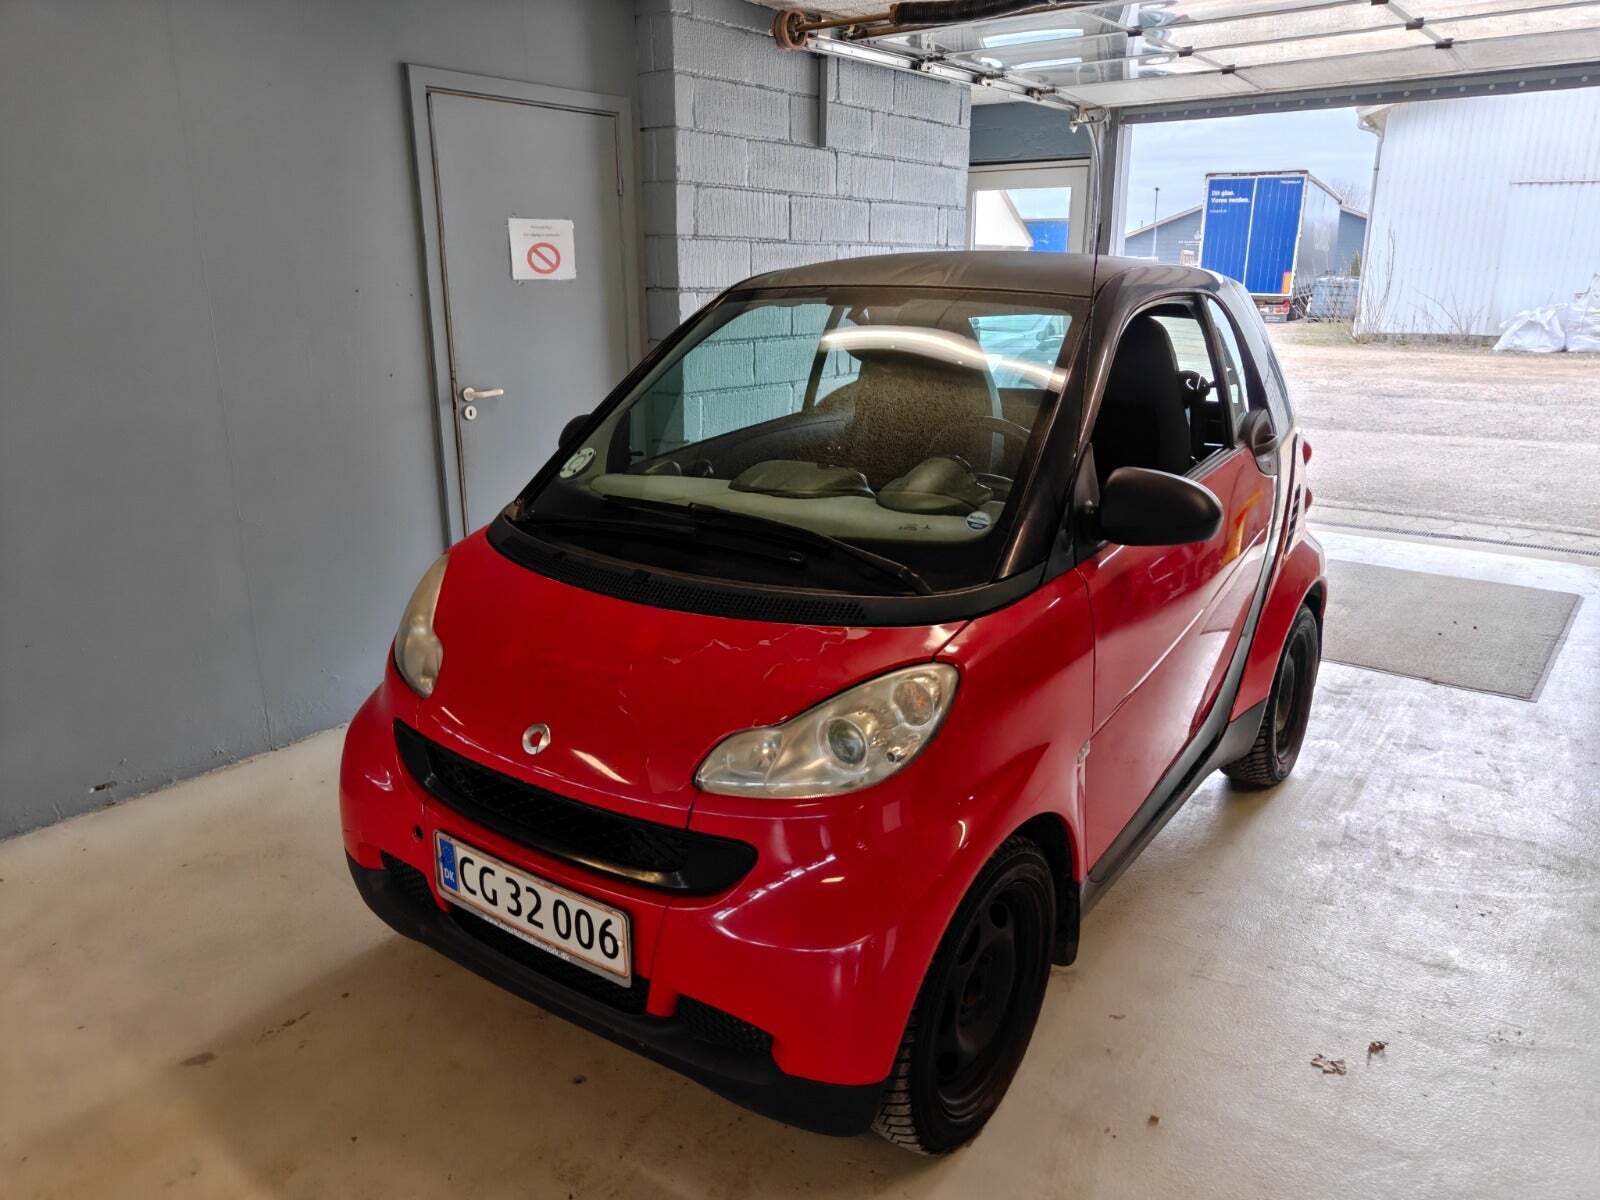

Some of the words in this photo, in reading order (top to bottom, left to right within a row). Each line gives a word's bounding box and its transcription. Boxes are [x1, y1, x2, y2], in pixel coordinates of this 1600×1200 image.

[444, 867, 455, 882] DK
[459, 856, 498, 906] CG
[505, 876, 544, 930] 32
[552, 899, 619, 960] 006
